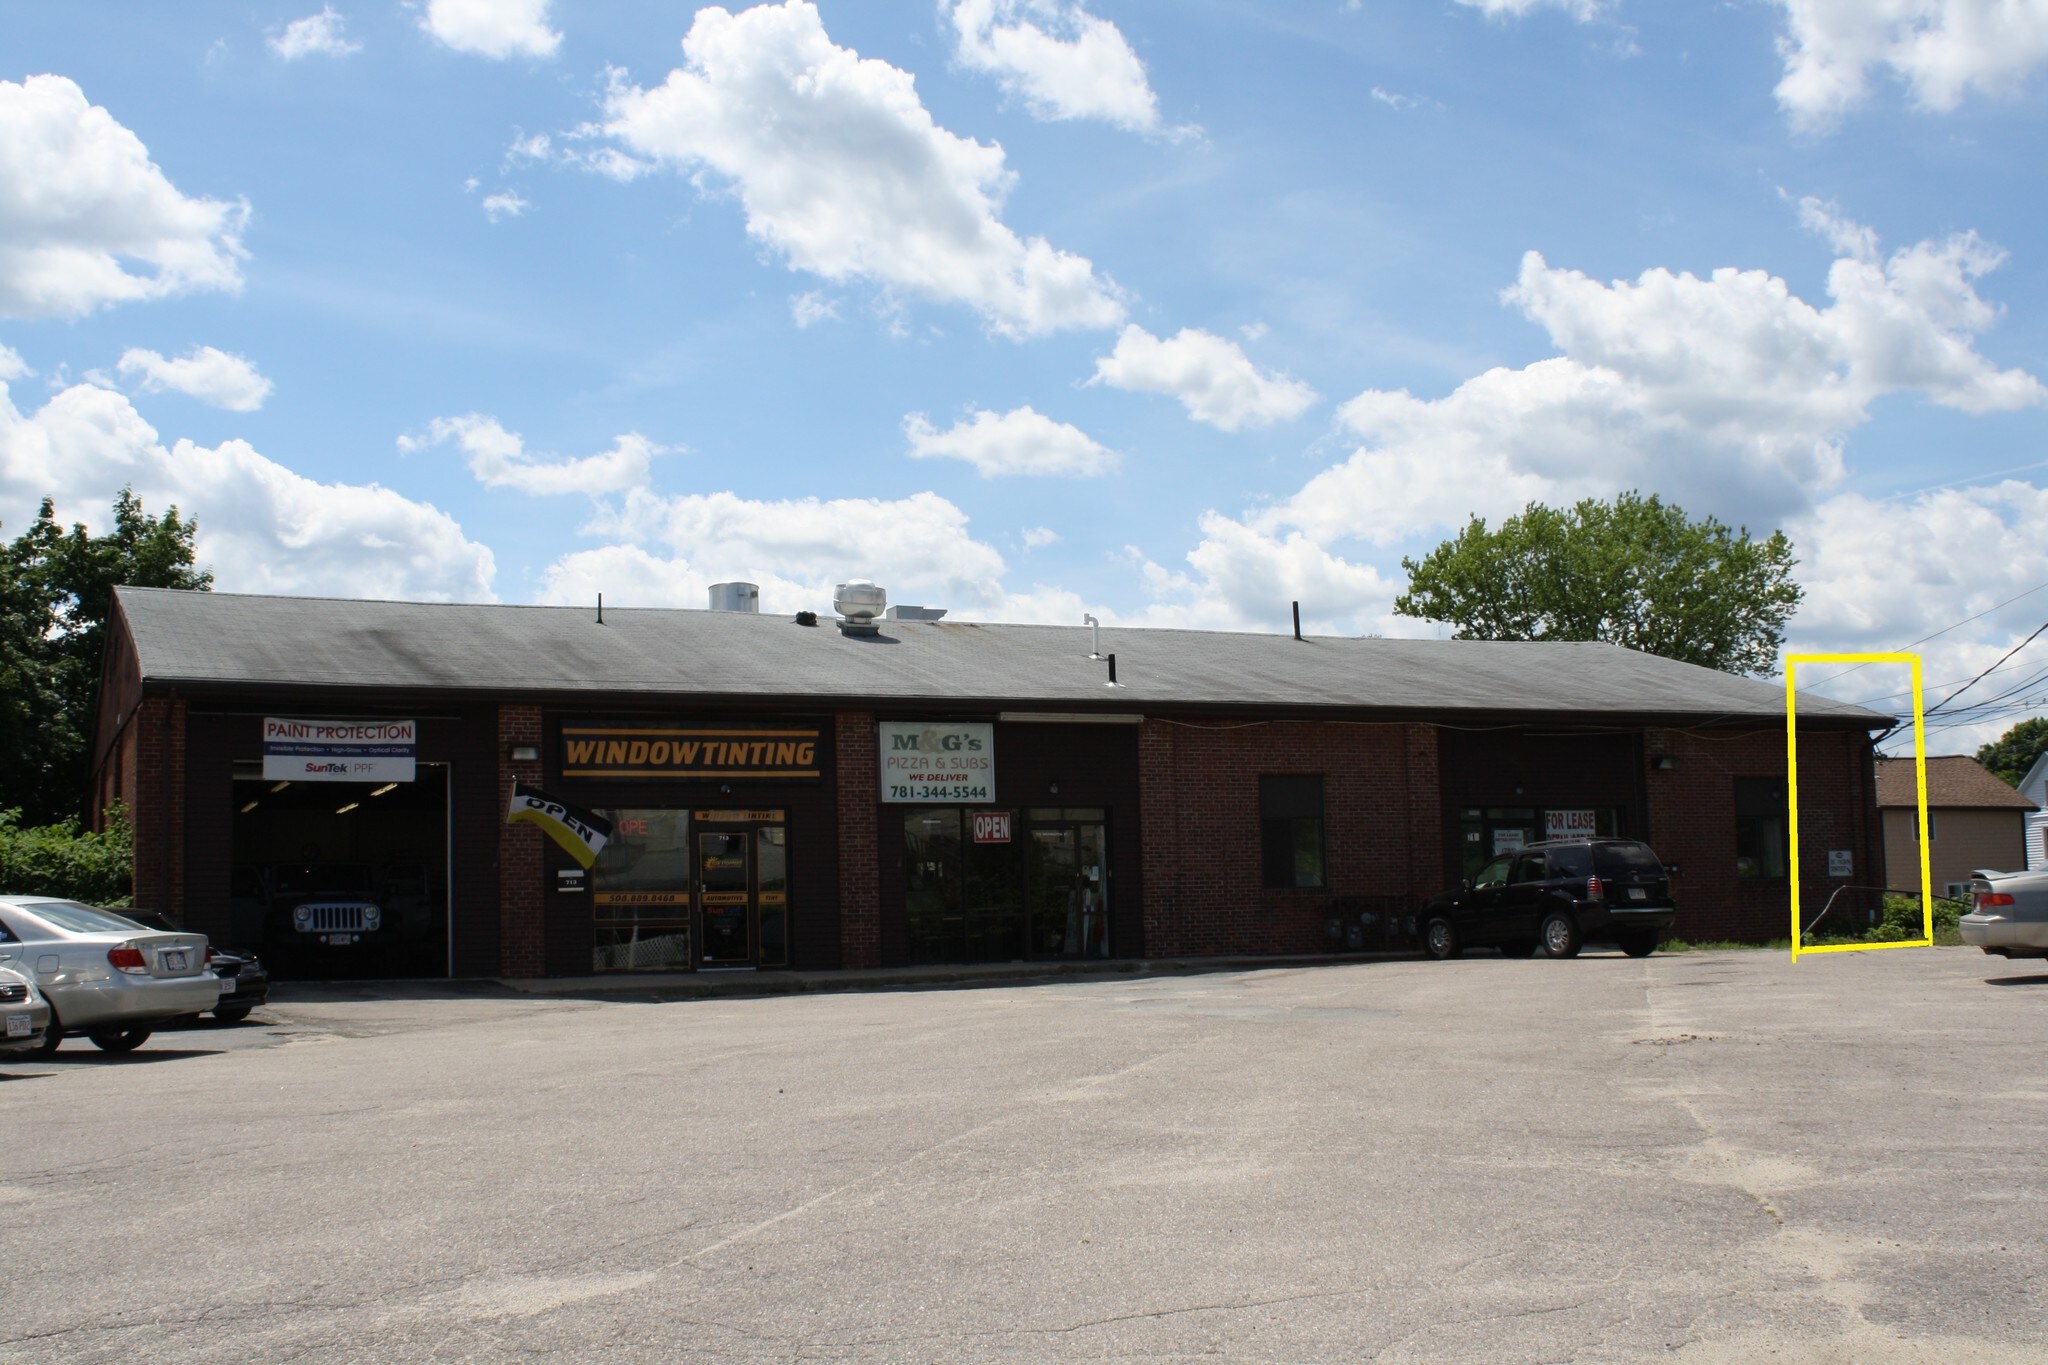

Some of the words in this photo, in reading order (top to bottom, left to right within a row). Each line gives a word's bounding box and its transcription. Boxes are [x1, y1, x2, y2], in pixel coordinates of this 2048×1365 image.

[268, 723, 311, 738] PAINT
[317, 725, 412, 739] PROTECTION
[892, 730, 982, 753] M&G's
[295, 745, 325, 753] Protection
[369, 746, 390, 754] Optical
[392, 747, 410, 755] Clarity
[306, 762, 348, 773] SunTek
[355, 763, 374, 773] PPF
[888, 757, 929, 769] PIZZA
[935, 757, 946, 769] &
[950, 757, 989, 769] SUBS
[927, 774, 968, 782] DELIVER
[891, 786, 986, 798] 781-344-5544
[526, 798, 594, 844] OPEN
[976, 816, 1009, 839] OPEN
[1546, 812, 1564, 830] FOR
[1567, 812, 1594, 830] LEASE
